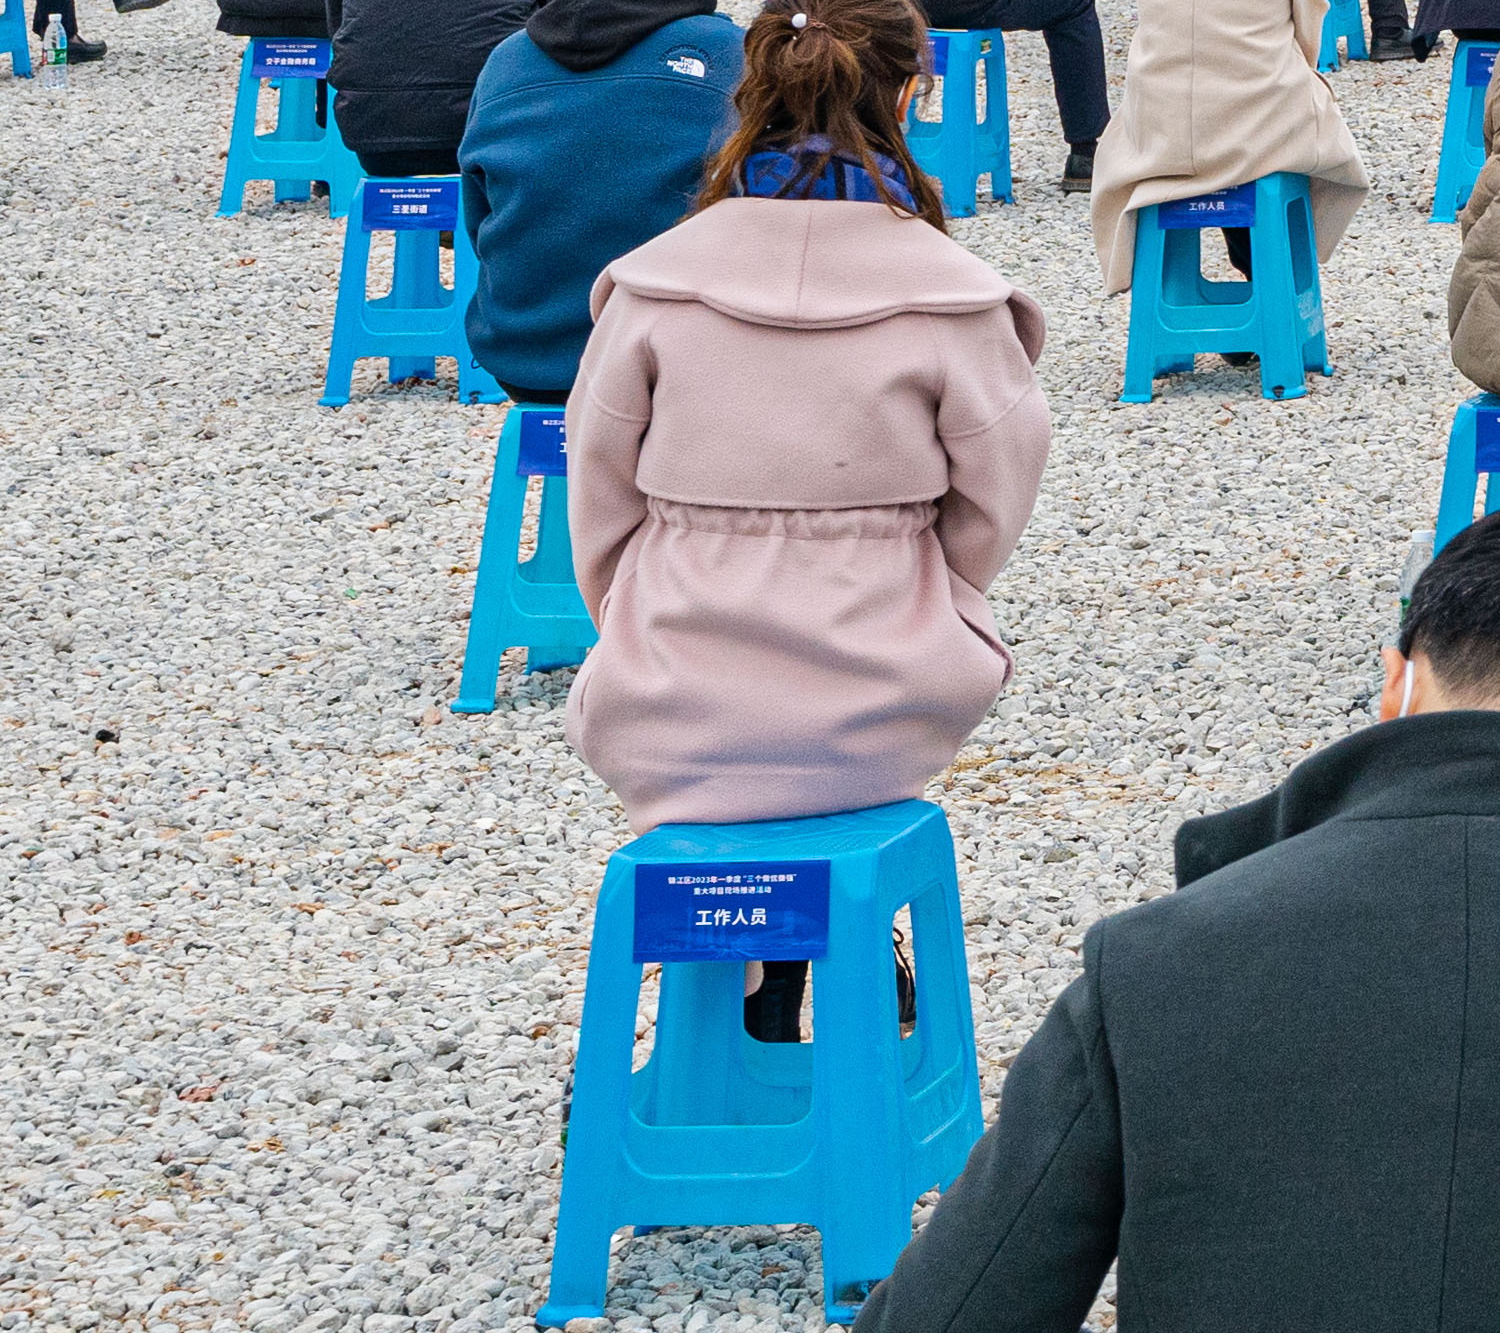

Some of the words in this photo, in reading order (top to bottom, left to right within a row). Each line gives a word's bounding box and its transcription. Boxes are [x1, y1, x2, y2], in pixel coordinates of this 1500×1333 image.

[1189, 201, 1224, 210] 工作人员
[696, 908, 766, 925] 工作人员
